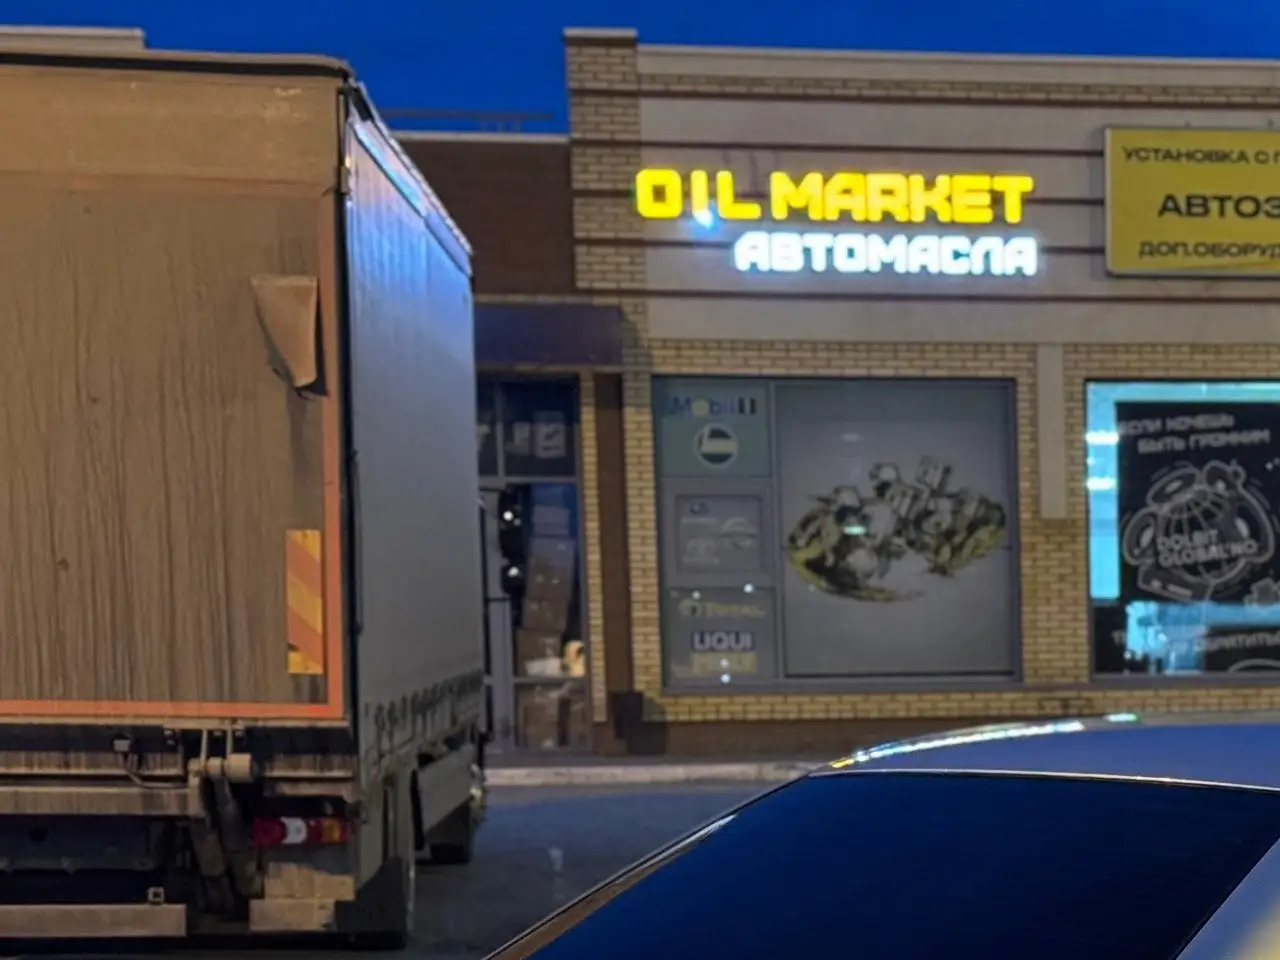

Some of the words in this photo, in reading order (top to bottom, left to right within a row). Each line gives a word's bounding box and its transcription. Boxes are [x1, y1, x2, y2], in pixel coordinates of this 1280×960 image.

[1122, 145, 1250, 163] УСТАНОВКА
[1254, 147, 1272, 165] С
[635, 168, 762, 219] OIL
[769, 171, 1034, 224] MARKET
[733, 230, 1038, 277] АВТОМАСЛА
